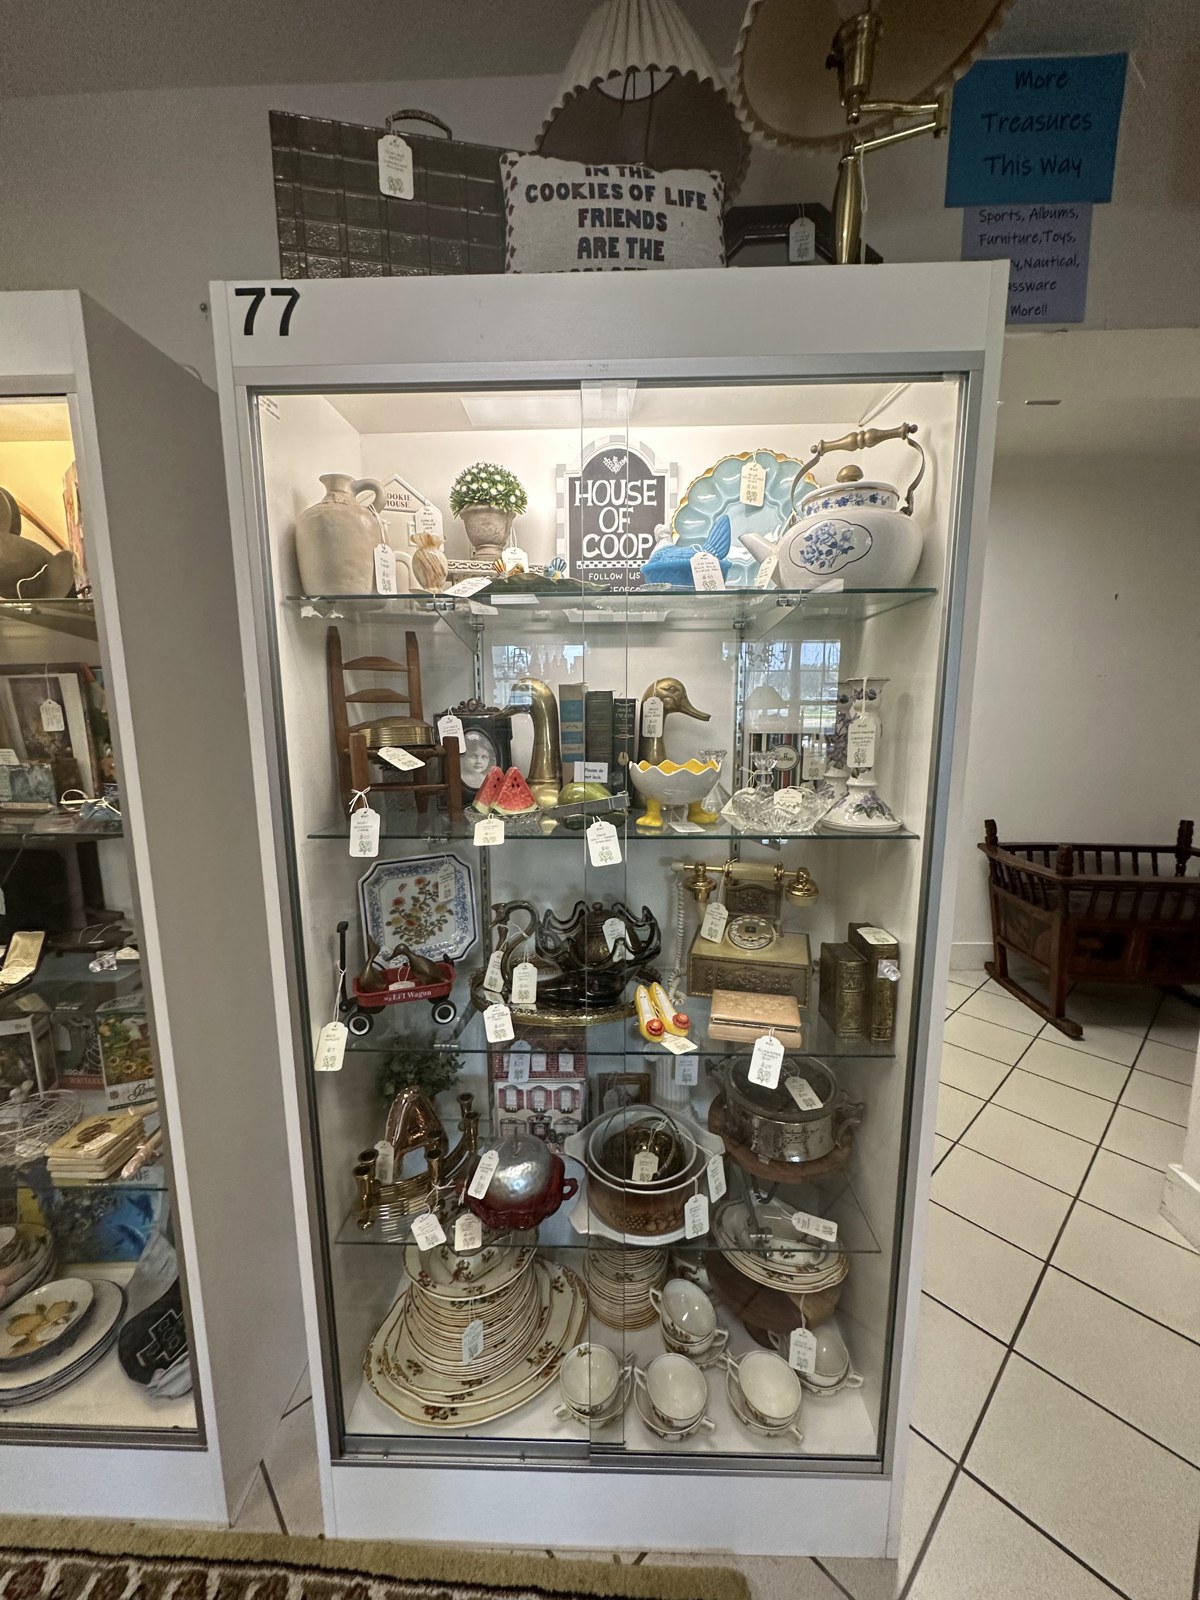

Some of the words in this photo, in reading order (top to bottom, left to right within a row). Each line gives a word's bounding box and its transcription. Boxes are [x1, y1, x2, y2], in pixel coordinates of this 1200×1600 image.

[1015, 69, 1069, 90] More
[981, 112, 1092, 133] Treasures
[616, 166, 655, 179] THE
[984, 154, 1032, 176] This
[1040, 155, 1082, 178] Way
[525, 182, 624, 203] COOKIES
[629, 184, 656, 202] OF
[664, 187, 708, 211] LIFE
[577, 208, 667, 232] FRIENDS
[979, 209, 1025, 225] Sports,
[1029, 207, 1079, 222] Albums,
[577, 236, 620, 259] ARE
[626, 237, 665, 261] THE
[234, 287, 301, 337] 77
[1011, 304, 1048, 317] More!!
[386, 492, 411, 501] OOKIE
[574, 479, 657, 507] HOUSE
[598, 506, 635, 533] OF
[582, 533, 654, 559] COOP
[588, 573, 624, 581] FOLLOW
[629, 572, 641, 580] US
[407, 990, 432, 999] Wagon
